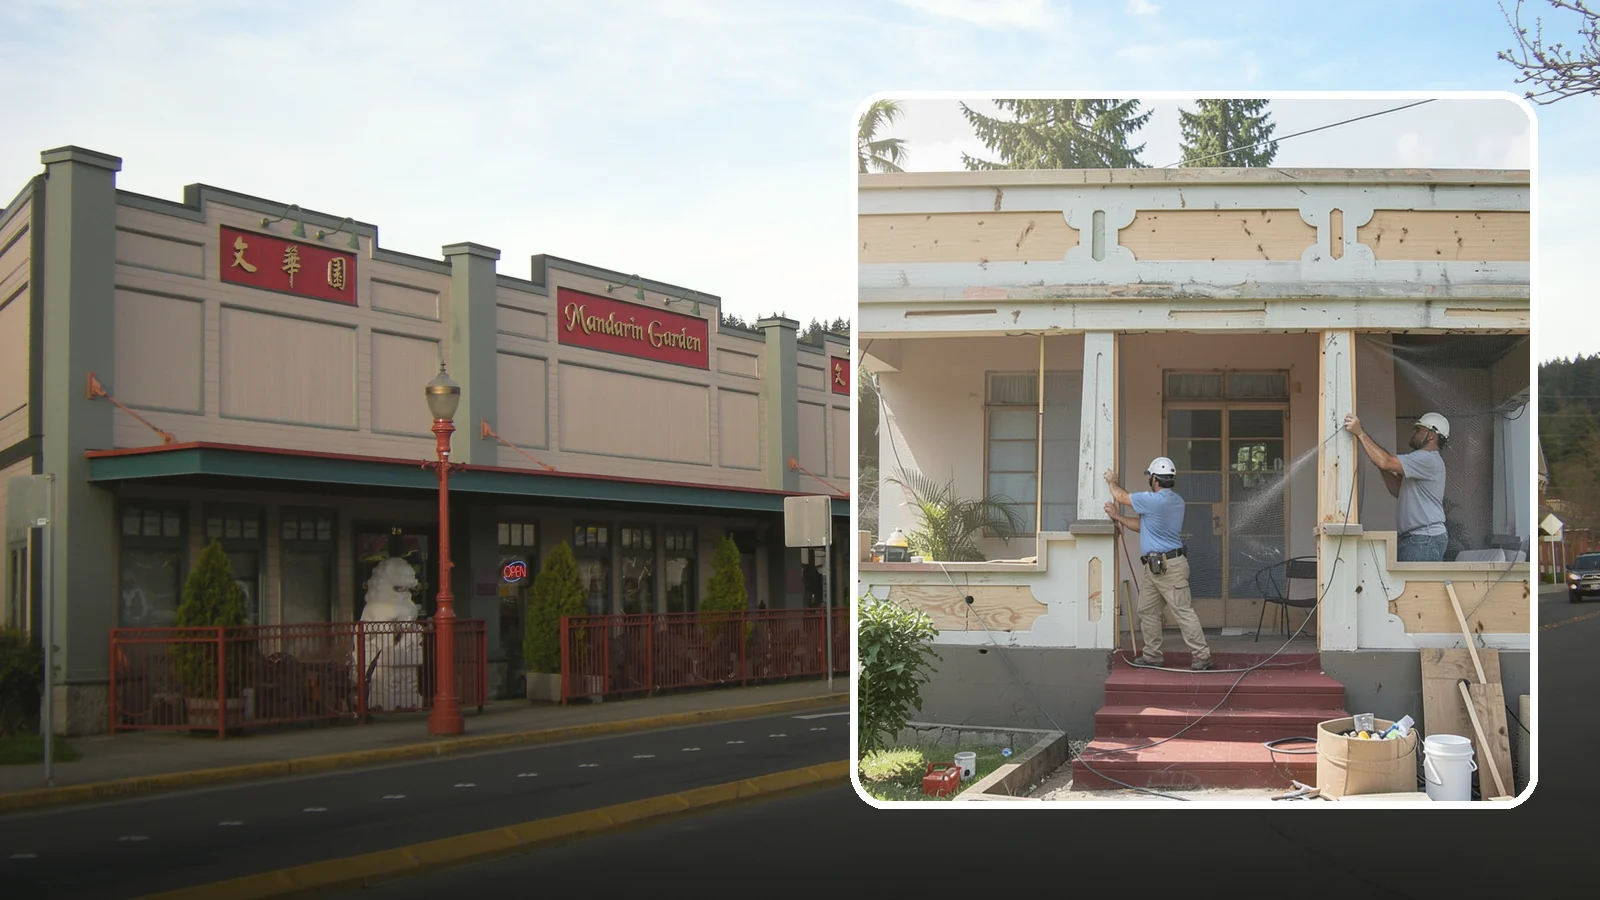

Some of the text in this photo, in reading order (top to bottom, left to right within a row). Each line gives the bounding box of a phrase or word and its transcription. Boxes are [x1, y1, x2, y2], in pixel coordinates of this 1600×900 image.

[231, 235, 346, 291] 文華園
[564, 302, 701, 352] Mandarin Garden
[835, 363, 846, 386] 文
[503, 565, 527, 578] OPEN
